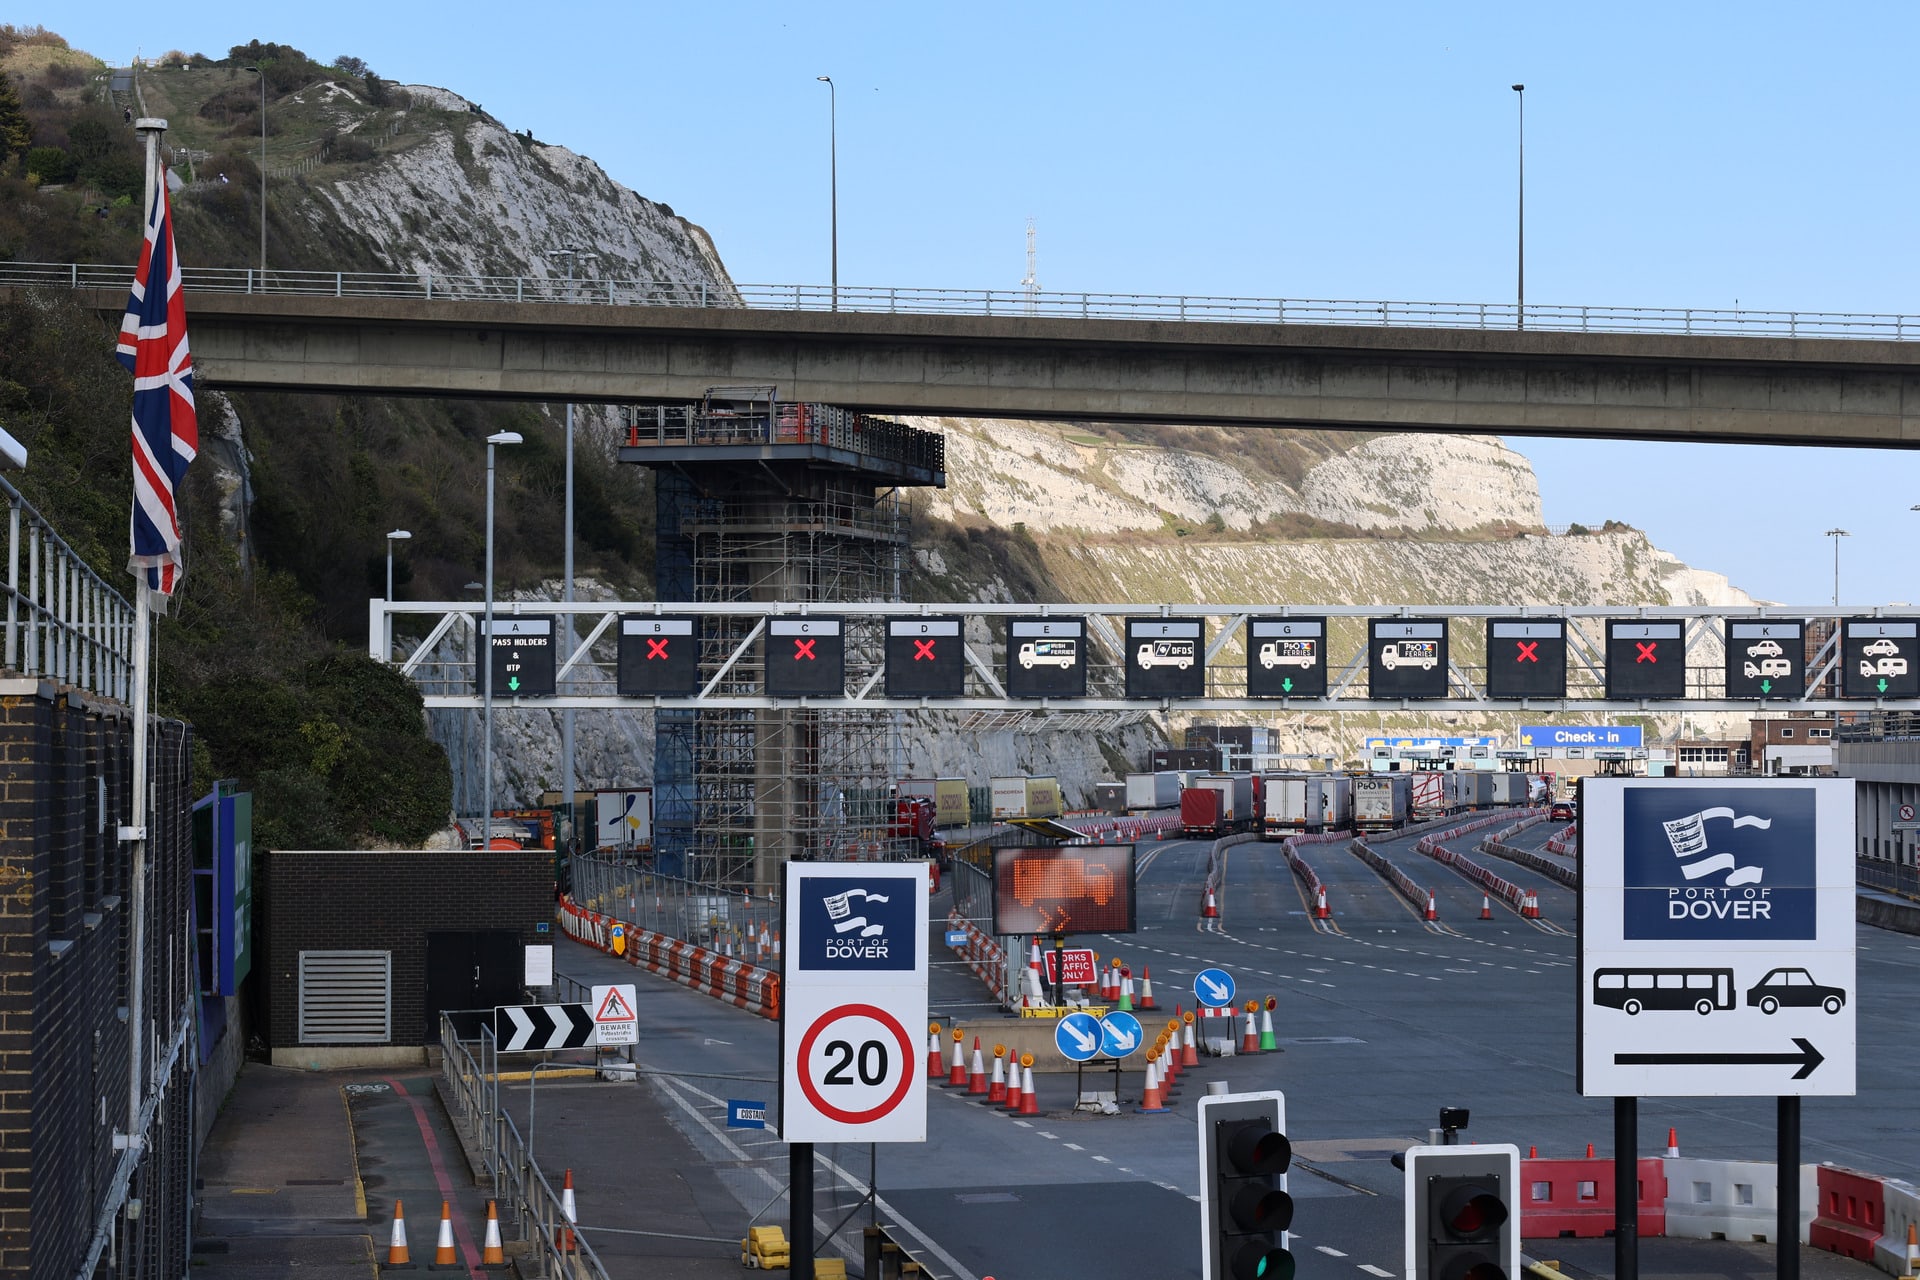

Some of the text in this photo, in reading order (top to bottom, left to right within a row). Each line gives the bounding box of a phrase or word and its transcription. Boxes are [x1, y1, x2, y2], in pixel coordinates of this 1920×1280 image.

[655, 624, 661, 632] B
[801, 624, 809, 632] C
[1162, 626, 1168, 634] F
[1284, 626, 1291, 634] G
[1406, 627, 1412, 635] H
[1879, 627, 1885, 635] L
[492, 638, 547, 646] PASS HOLDERS
[1284, 642, 1300, 650] P&O
[1171, 646, 1193, 655] DFDS
[1405, 643, 1422, 651] P&O
[1555, 731, 1596, 743] Check
[1607, 731, 1619, 743] in
[1357, 782, 1376, 790] P&O
[1669, 888, 1772, 899] PORT OF
[1669, 900, 1772, 920] DOVER
[826, 946, 888, 958] DOVER
[1051, 962, 1090, 971] TAFFIC
[600, 1023, 631, 1031] BEWARE
[823, 1039, 888, 1086] 20
[741, 1109, 766, 1120] COSTAIN
